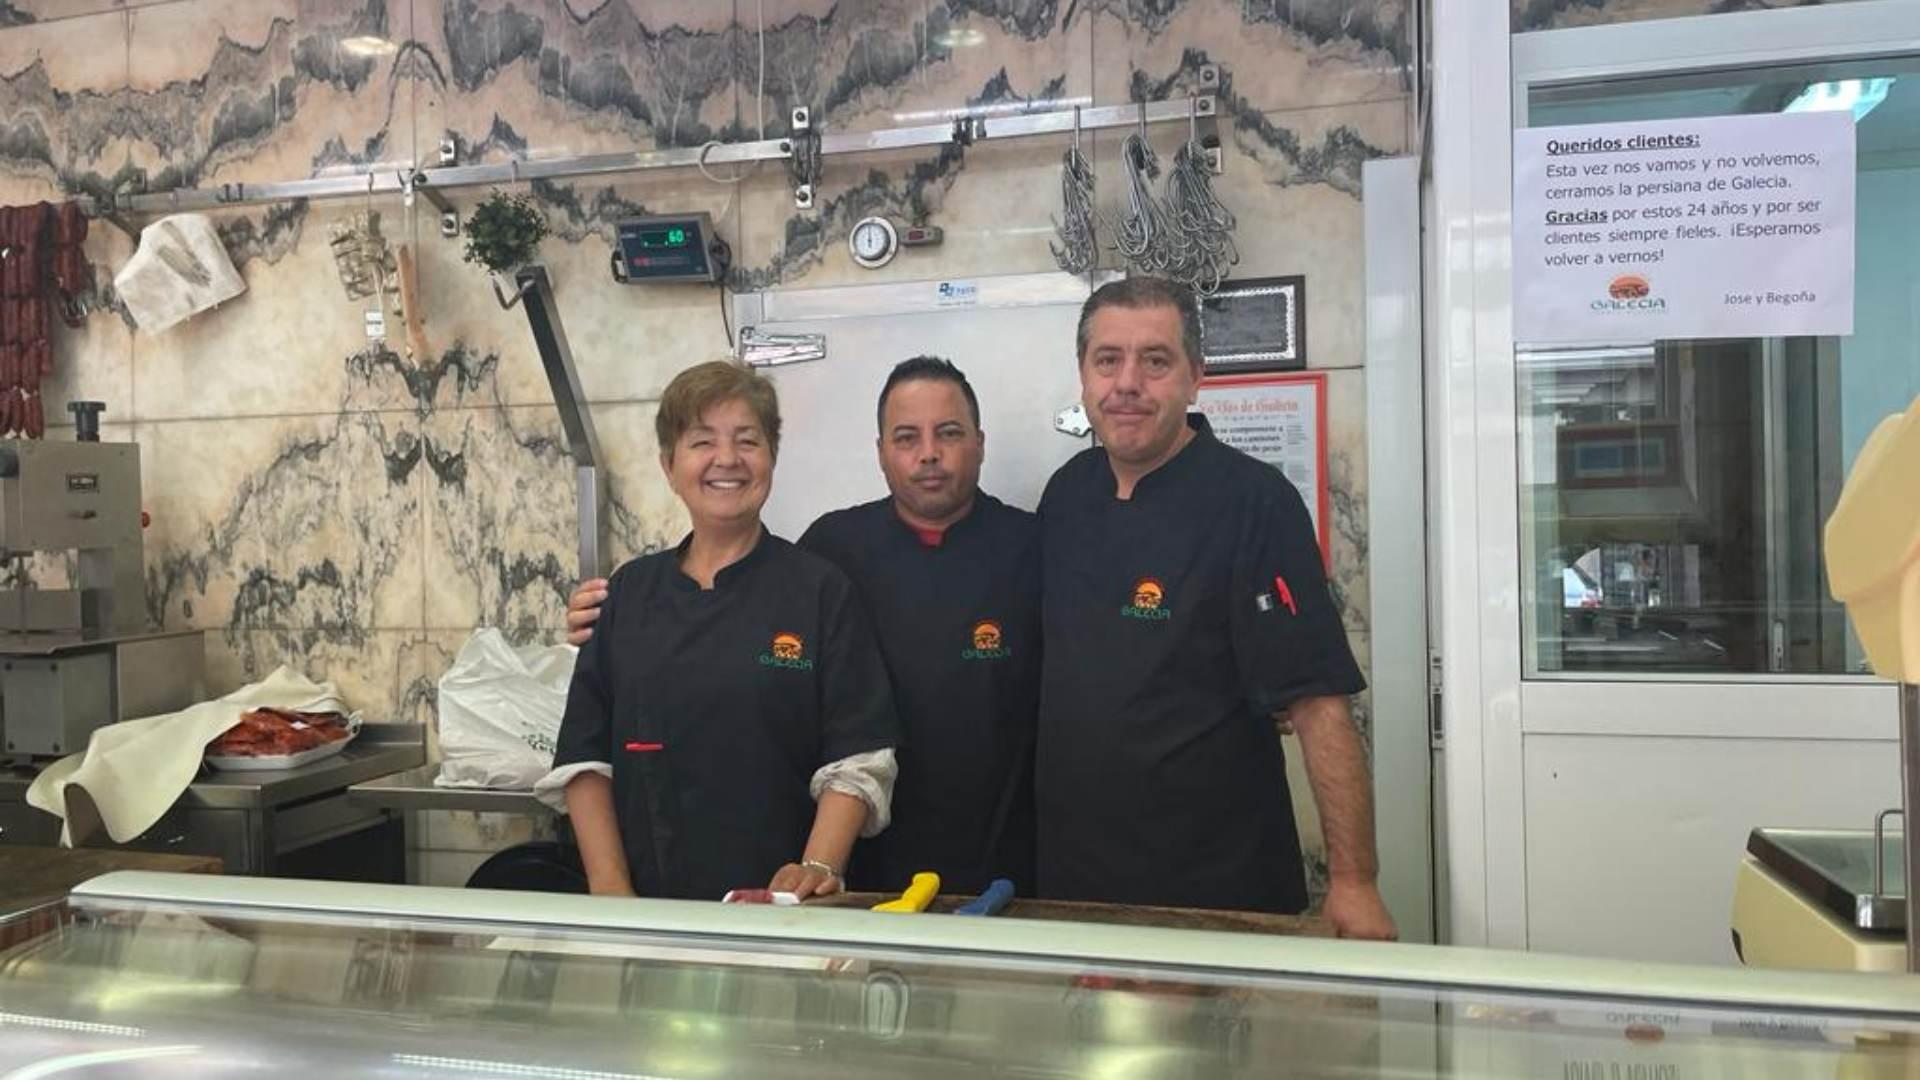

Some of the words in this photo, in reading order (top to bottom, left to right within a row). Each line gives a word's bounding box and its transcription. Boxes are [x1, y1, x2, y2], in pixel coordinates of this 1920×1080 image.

[1546, 137, 1622, 155] Queridos
[1626, 134, 1700, 151] clientes:
[1546, 164, 1577, 178] Esta
[1583, 164, 1608, 176] vez
[1614, 161, 1640, 174] nos
[1646, 159, 1696, 172] vamos
[1702, 159, 1711, 171] y
[1717, 156, 1737, 168] no
[1742, 153, 1820, 168] volvemos,
[1545, 185, 1614, 200] cerramos
[1619, 183, 1632, 196] la
[1637, 180, 1701, 197] persiana
[1707, 178, 1726, 191] de
[1731, 175, 1792, 190] Galecia.
[1545, 207, 1608, 226] Gracias
[1612, 209, 1637, 223] por
[1642, 204, 1682, 219] estos
[1687, 203, 1706, 217] 24
[1711, 200, 1748, 216] años
[1752, 203, 1761, 216] y
[1767, 201, 1792, 215] por
[1797, 200, 1821, 212] ser
[1545, 230, 1601, 245] clientes
[1608, 228, 1668, 242] siempre
[1676, 224, 1721, 239] fieles.
[1545, 252, 1589, 266] volver
[1595, 253, 1604, 264] a
[1608, 249, 1664, 264] vernos!
[1724, 294, 1752, 306] Jose
[1756, 296, 1764, 307] y
[1766, 291, 1817, 308] Begoña
